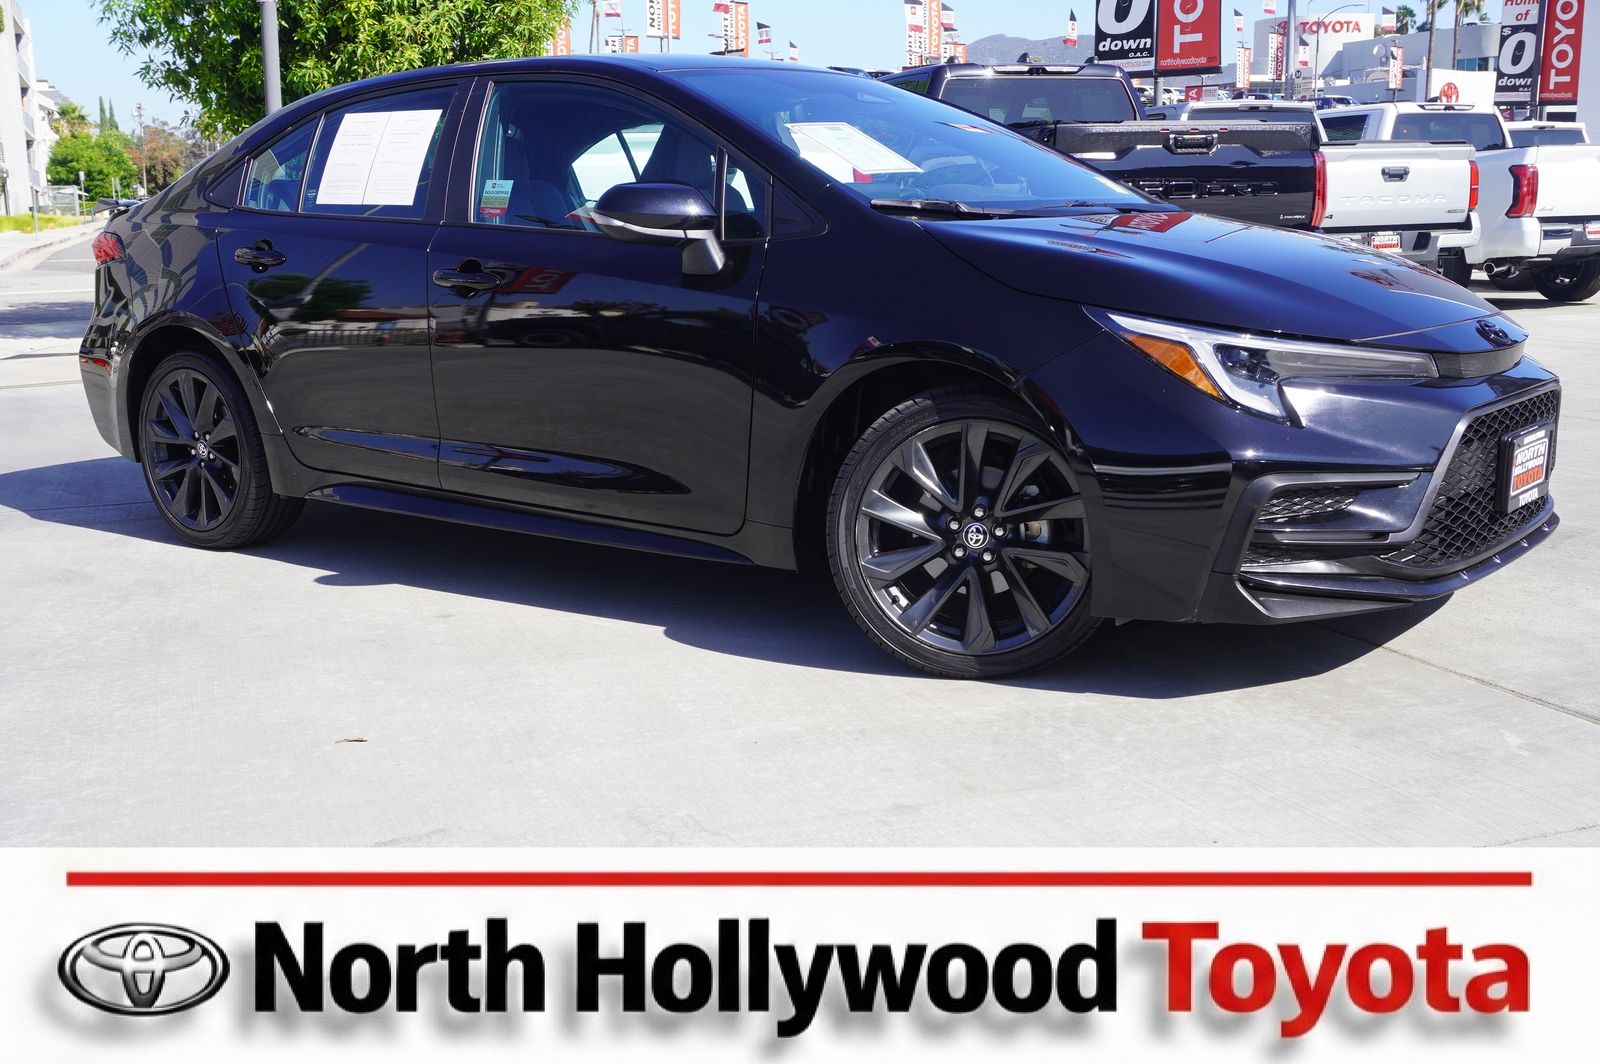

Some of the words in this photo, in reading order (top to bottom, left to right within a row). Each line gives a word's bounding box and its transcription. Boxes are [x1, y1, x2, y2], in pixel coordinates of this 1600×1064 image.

[1515, 9, 1531, 22] of
[738, 5, 746, 50] OYOTA
[1300, 20, 1362, 34] TOYOTA
[1098, 37, 1152, 52] down
[1276, 36, 1284, 76] TOYOTA
[1339, 193, 1448, 206] TACOMA
[1516, 442, 1546, 466] NORTH
[1512, 465, 1544, 491] TOYOTA
